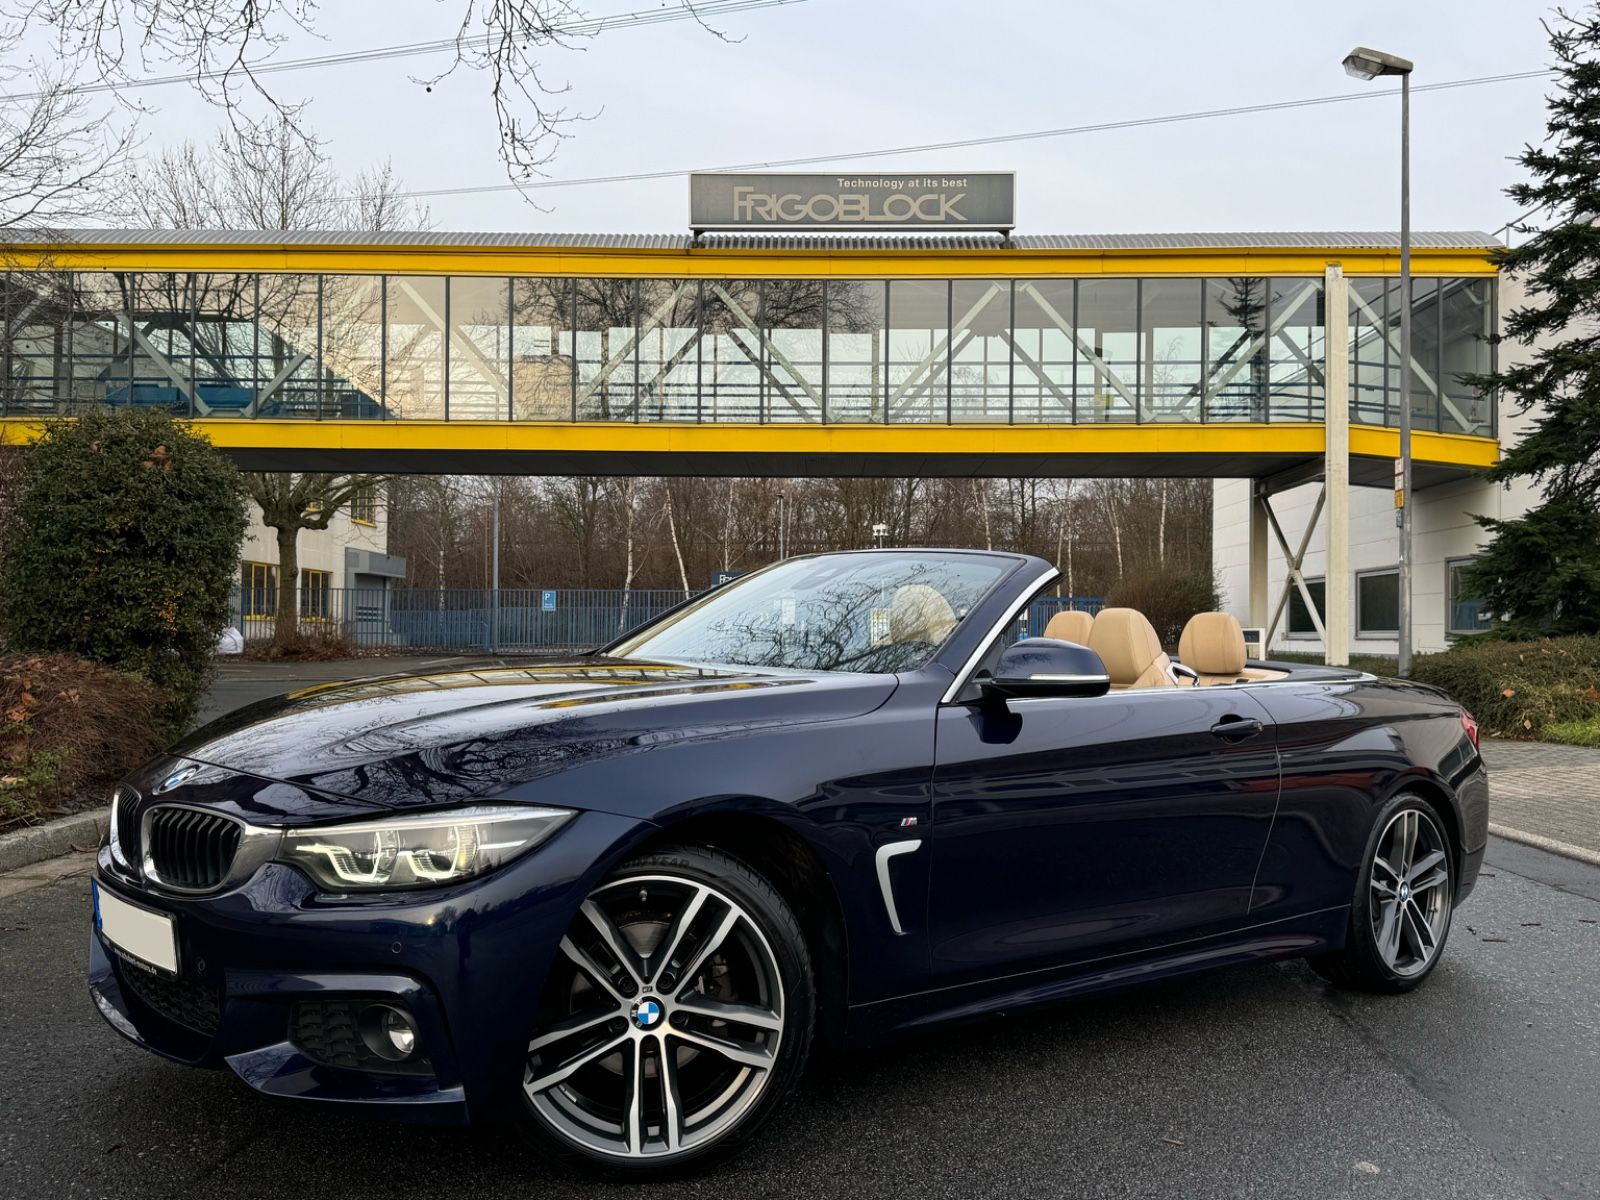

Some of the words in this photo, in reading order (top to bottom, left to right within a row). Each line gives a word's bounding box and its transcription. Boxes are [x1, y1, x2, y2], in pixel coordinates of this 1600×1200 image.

[837, 178, 904, 190] Technology
[908, 179, 919, 187] at
[923, 178, 938, 187] its
[942, 178, 968, 187] best
[733, 186, 968, 221] FRIGOBLOCK
